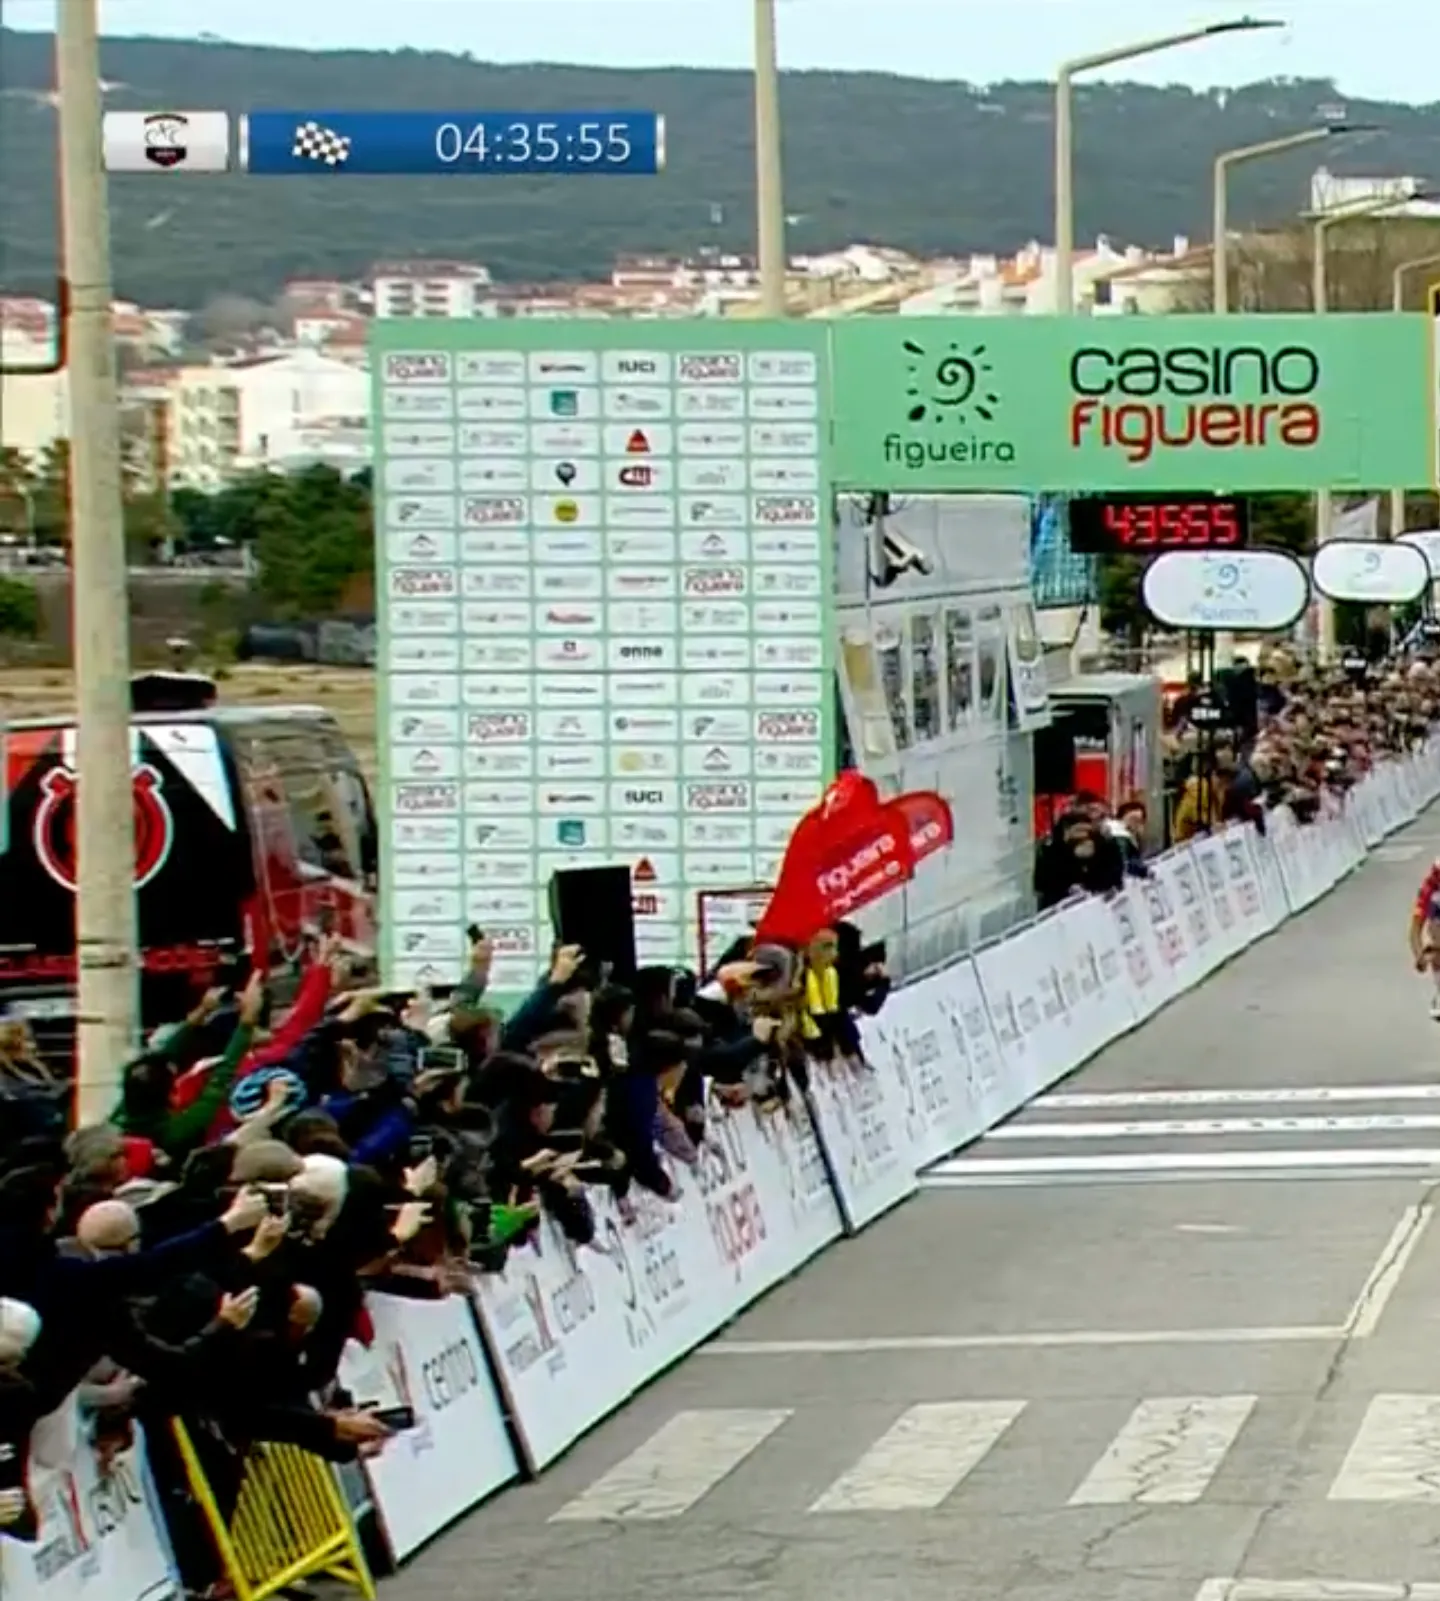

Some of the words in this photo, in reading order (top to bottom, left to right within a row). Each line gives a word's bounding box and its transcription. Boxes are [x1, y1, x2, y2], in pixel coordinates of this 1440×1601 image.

[1069, 346, 1320, 397] casino
[883, 434, 1016, 469] figueira
[1069, 400, 1320, 462] figueira
